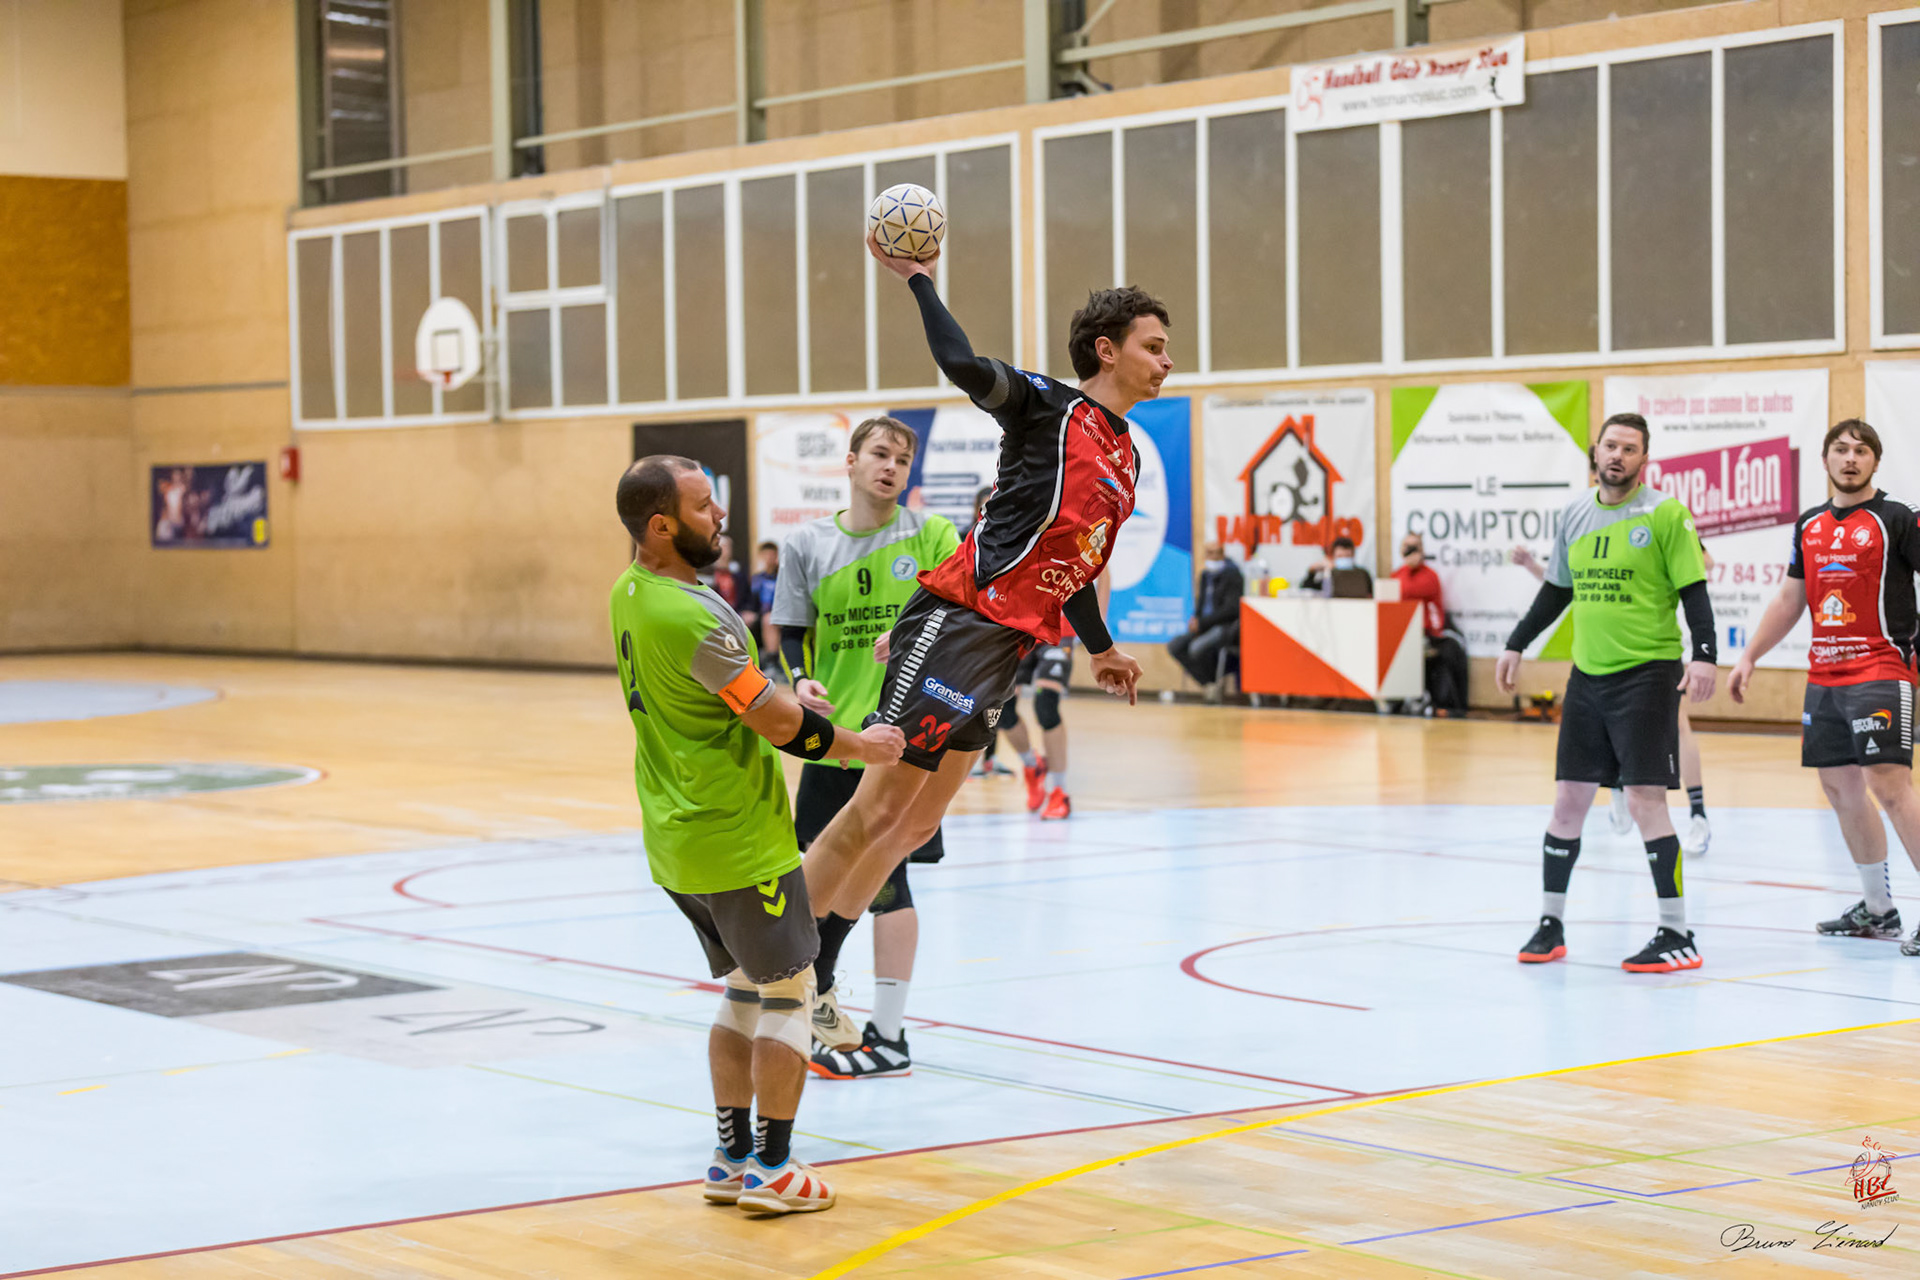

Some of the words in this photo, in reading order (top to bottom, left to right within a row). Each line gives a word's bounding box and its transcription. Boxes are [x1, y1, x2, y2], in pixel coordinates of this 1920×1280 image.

[1476, 476, 1498, 497] LE
[1721, 445, 1781, 510] Léon
[857, 567, 872, 597] 9
